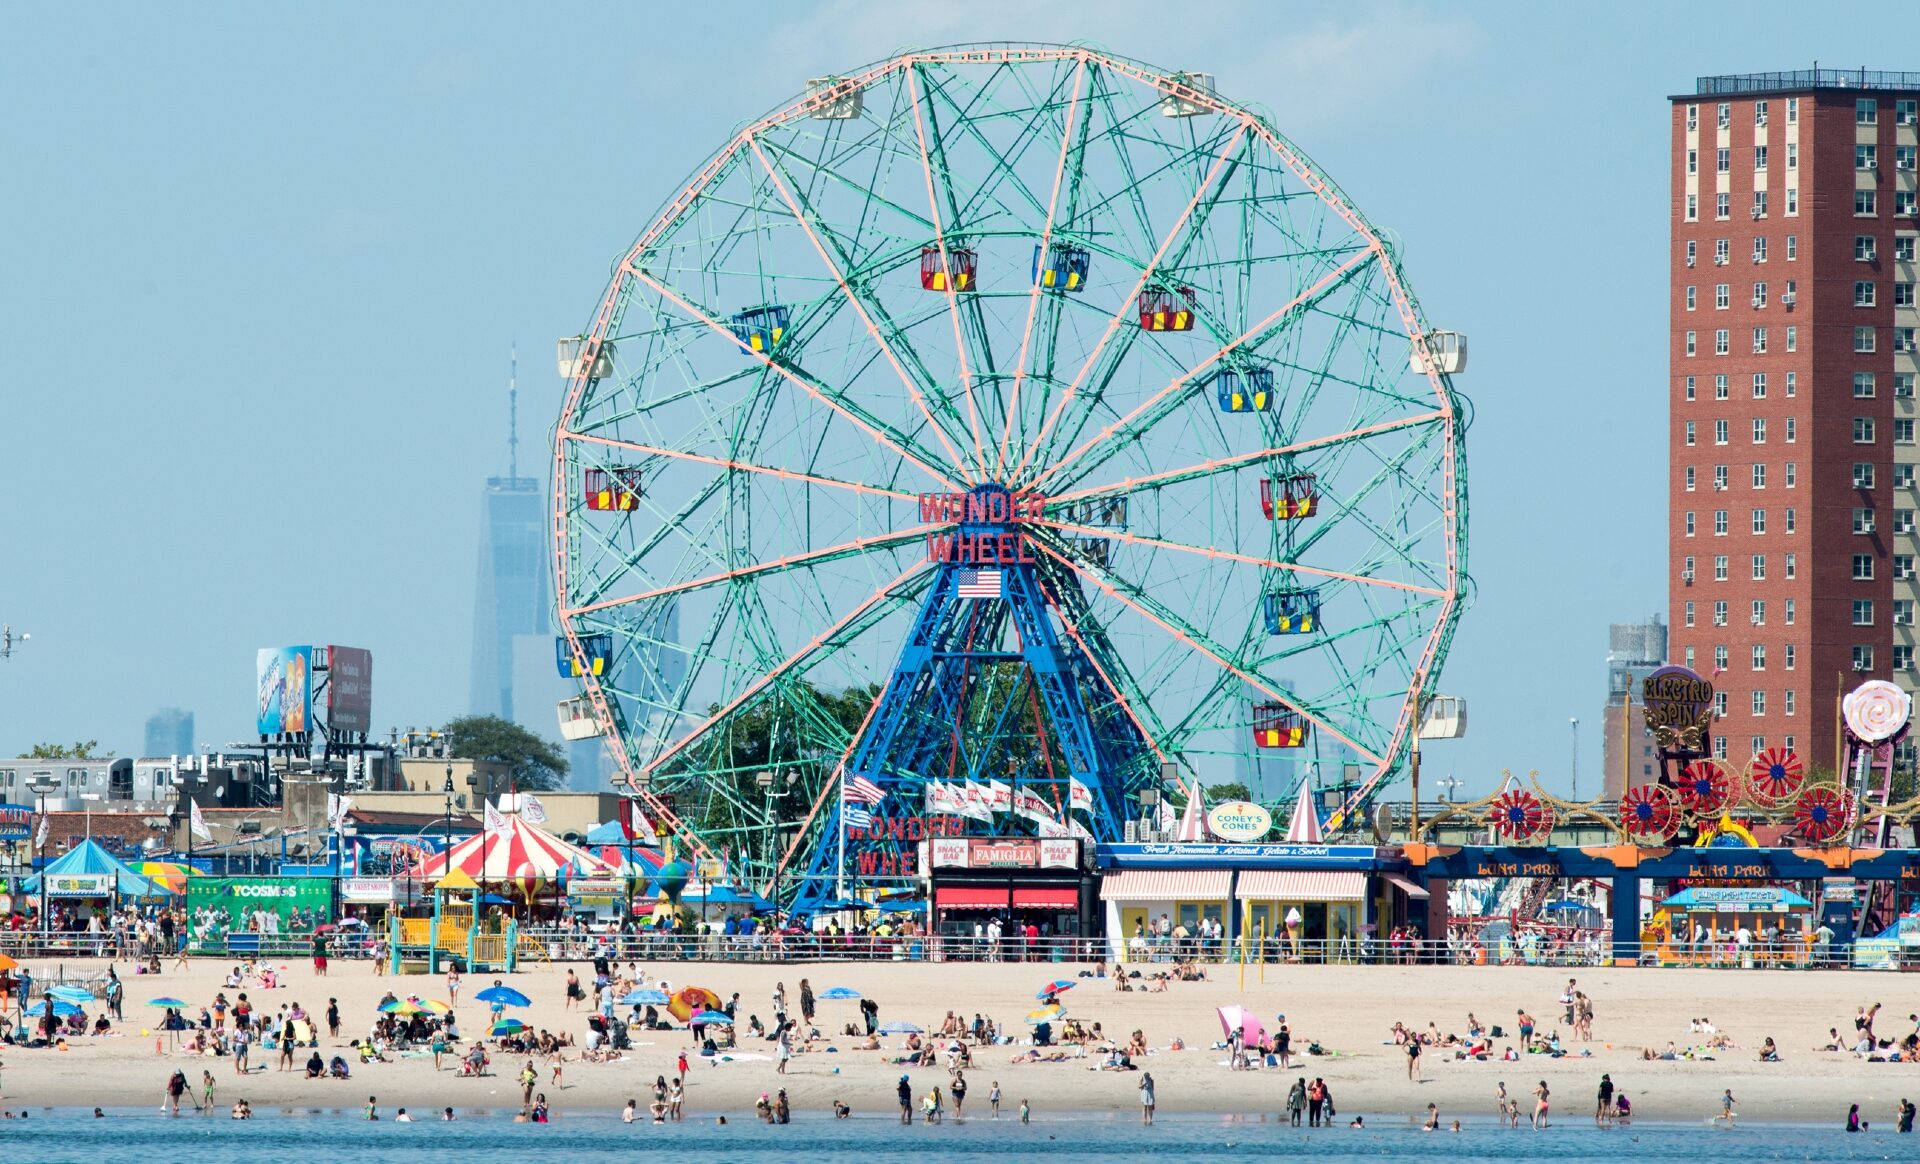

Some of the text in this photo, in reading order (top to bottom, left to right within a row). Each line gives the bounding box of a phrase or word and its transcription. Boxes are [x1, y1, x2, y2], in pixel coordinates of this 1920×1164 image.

[918, 492, 1045, 523] WONDER
[927, 533, 1036, 563] WHEEL
[1643, 677, 1713, 703] ELECTRO
[1658, 702, 1693, 725] SPIN
[1217, 815, 1262, 823] CONEY'S
[975, 850, 1033, 861] FAMIGLIA
[1044, 846, 1072, 854] SNACK
[1142, 845, 1169, 854] Fresh
[1169, 845, 1219, 855] Homemade
[1262, 846, 1289, 856] Gelato
[1298, 847, 1328, 855] Sorbet
[857, 851, 916, 876] WHE
[1478, 863, 1560, 875] LUNA PARK
[1689, 865, 1772, 877] LUNA PARK
[1721, 890, 1743, 900] PARK
[1744, 891, 1777, 900] TICKETS
